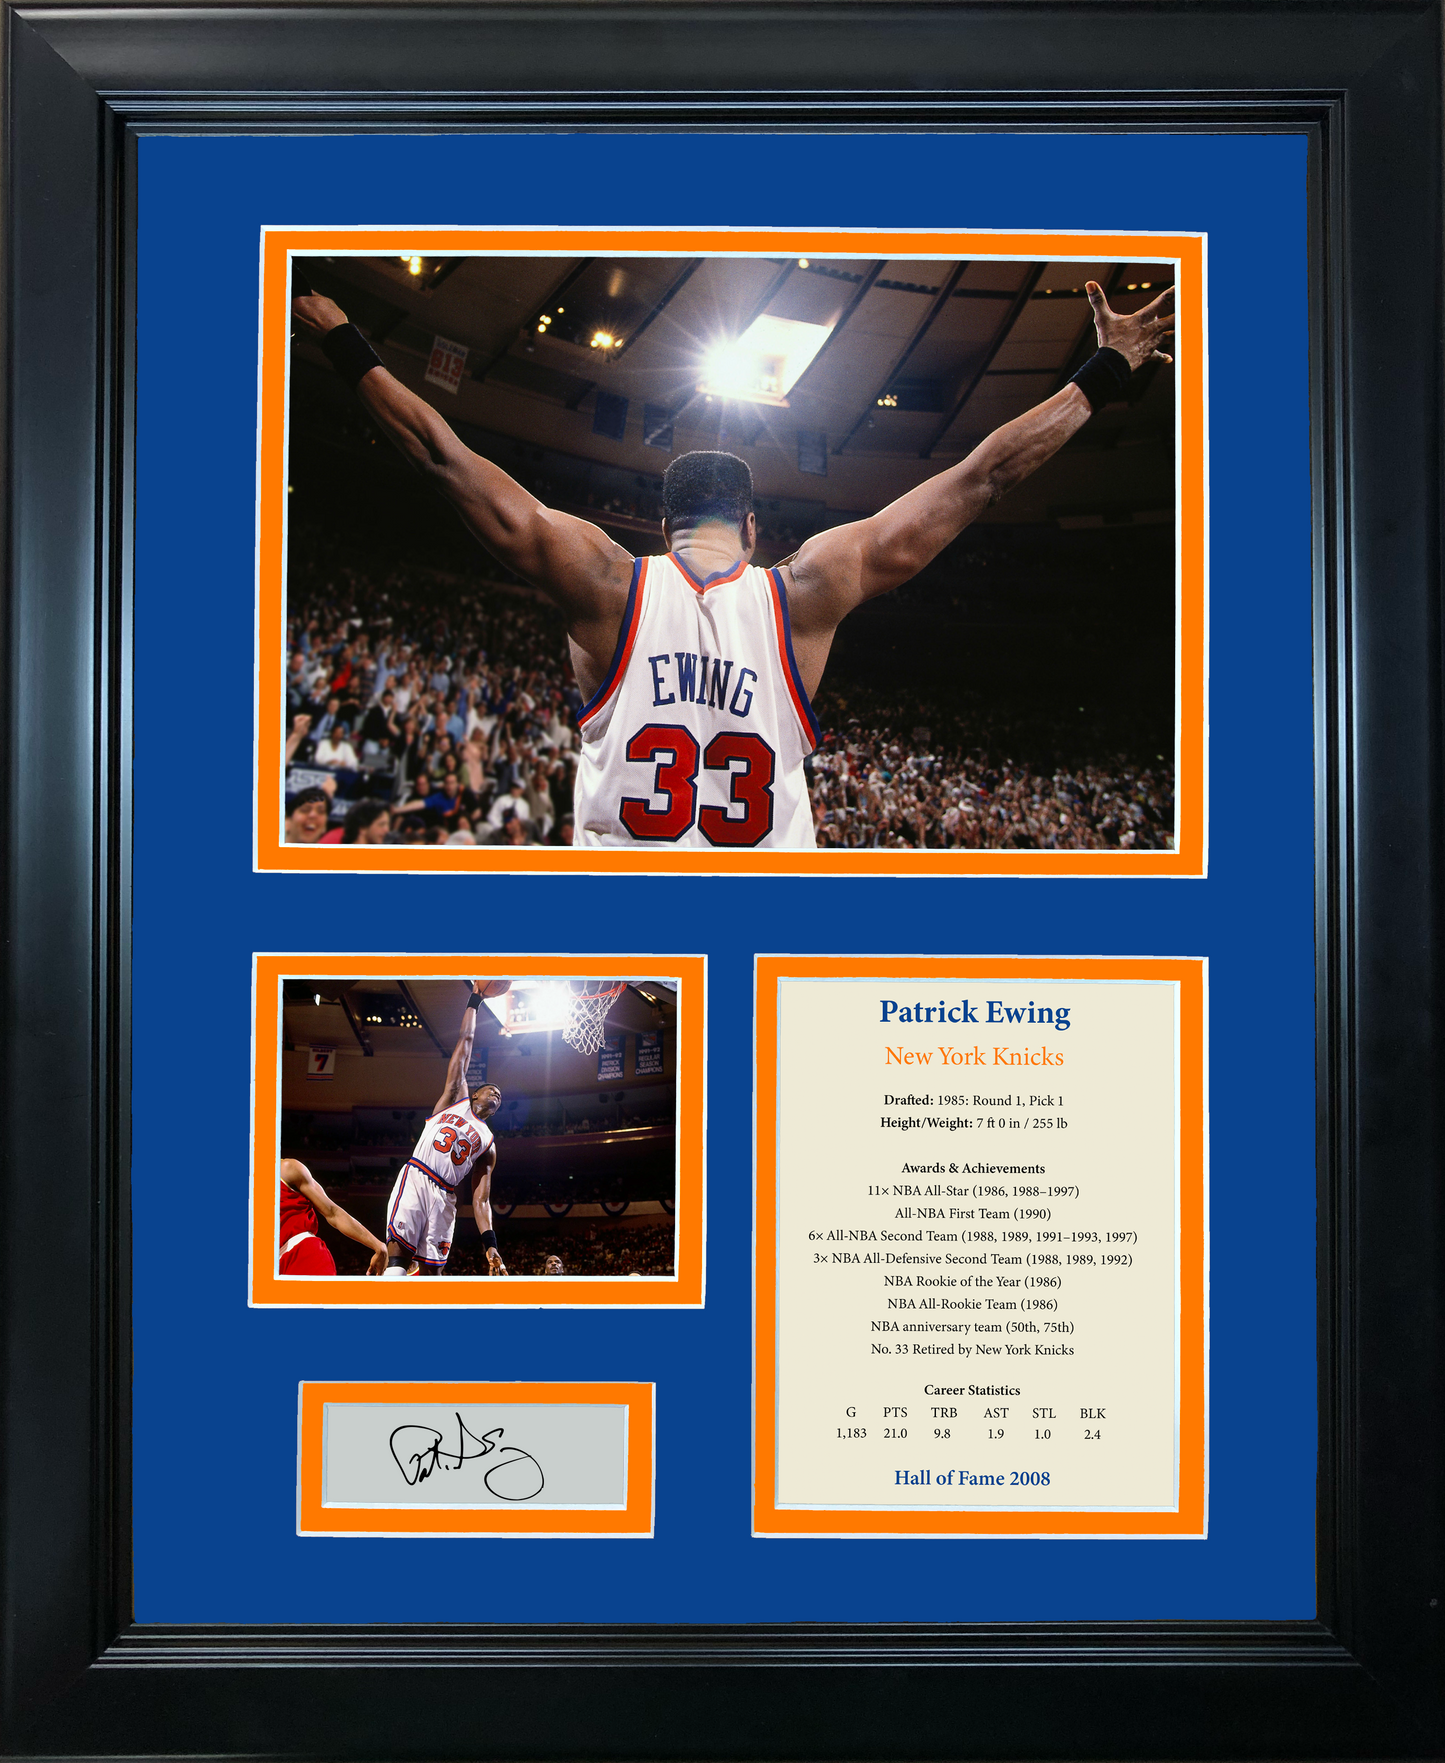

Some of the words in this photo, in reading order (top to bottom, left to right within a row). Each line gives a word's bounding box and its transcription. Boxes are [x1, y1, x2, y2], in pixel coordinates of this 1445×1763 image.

[648, 652, 758, 718] EWING
[619, 723, 776, 847] 33
[879, 998, 980, 1024] Patrick
[984, 1000, 1072, 1032] Ewing
[314, 1053, 329, 1072] 7
[884, 1046, 934, 1066] New
[937, 1045, 987, 1066] York
[992, 1045, 1065, 1067] Knicks
[883, 1093, 934, 1106] Drafted:
[937, 1094, 969, 1106] 1985:
[972, 1094, 1013, 1107] Round
[1015, 1095, 1026, 1108] 1,
[1029, 1094, 1055, 1107] Pick
[1058, 1095, 1064, 1107] 1
[437, 1113, 469, 1128] NEW
[880, 1116, 973, 1132] Height/Weight:
[976, 1117, 984, 1129] 7
[986, 1116, 996, 1129] ft
[998, 1117, 1006, 1129] 0
[1008, 1117, 1021, 1129] in
[1023, 1117, 1030, 1130] /
[1032, 1117, 1054, 1129] 255
[1056, 1116, 1069, 1130] lb
[433, 1126, 472, 1166] 33
[901, 1161, 946, 1174] Awards
[948, 1162, 960, 1174] &
[961, 1162, 1046, 1175] Achievements
[892, 1184, 922, 1196] NBA
[923, 1184, 970, 1197] All-Star
[972, 1184, 1009, 1199] (1986,
[894, 1206, 946, 1219] All-NBA
[948, 1207, 976, 1220] First
[977, 1207, 1010, 1220] Team
[1013, 1207, 1052, 1222] (1990)
[826, 1229, 878, 1242] All-NBA
[880, 1229, 923, 1242] Second
[925, 1230, 958, 1242] Team
[961, 1229, 998, 1245] (1988,
[1001, 1231, 1033, 1244] 1989,
[1105, 1230, 1138, 1246] 1997)
[831, 1251, 861, 1265] NBA
[862, 1251, 943, 1265] All-Defensive
[944, 1252, 988, 1265] Second
[990, 1253, 1023, 1265] Team
[1025, 1252, 1063, 1268] (1988,
[1066, 1254, 1097, 1267] 1989,
[1101, 1253, 1133, 1268] 1992)
[883, 1275, 914, 1287] NBA
[915, 1274, 958, 1287] Rookie
[959, 1274, 973, 1288] of
[974, 1275, 994, 1288] the
[995, 1275, 1022, 1288] Year
[1024, 1275, 1062, 1290] (1986)
[887, 1298, 917, 1310] NBA
[918, 1297, 983, 1310] All-Rookie
[984, 1298, 1018, 1310] Team
[1020, 1297, 1058, 1313] (1986)
[870, 1320, 901, 1332] NBA
[902, 1320, 972, 1336] anniversary
[973, 1322, 1003, 1333] team
[1005, 1320, 1041, 1335] (50th,
[1043, 1320, 1075, 1336] 75th)
[870, 1343, 892, 1355] No.
[894, 1343, 909, 1355] 33
[912, 1342, 955, 1355] Retired
[957, 1342, 973, 1359] by
[975, 1343, 1003, 1356] New
[1004, 1343, 1032, 1356] York
[1034, 1343, 1075, 1356] Knicks
[923, 1384, 966, 1396] Career
[967, 1384, 1021, 1396] Statistics
[845, 1406, 857, 1418] G
[883, 1406, 908, 1418] PTS
[930, 1406, 958, 1419] TRB
[983, 1407, 1010, 1419] AST
[1032, 1407, 1057, 1419] STL
[1079, 1407, 1107, 1420] BLK
[836, 1427, 868, 1440] 1,183
[883, 1427, 908, 1439] 21.0
[933, 1428, 951, 1440] 9.8
[988, 1428, 1005, 1440] 1.9
[1034, 1428, 1052, 1440] 1.0
[1083, 1428, 1102, 1440] 2.4
[894, 1469, 932, 1486] Hall
[935, 1469, 955, 1487] of
[957, 1470, 1006, 1487] Fame
[1009, 1471, 1051, 1487] 2008
